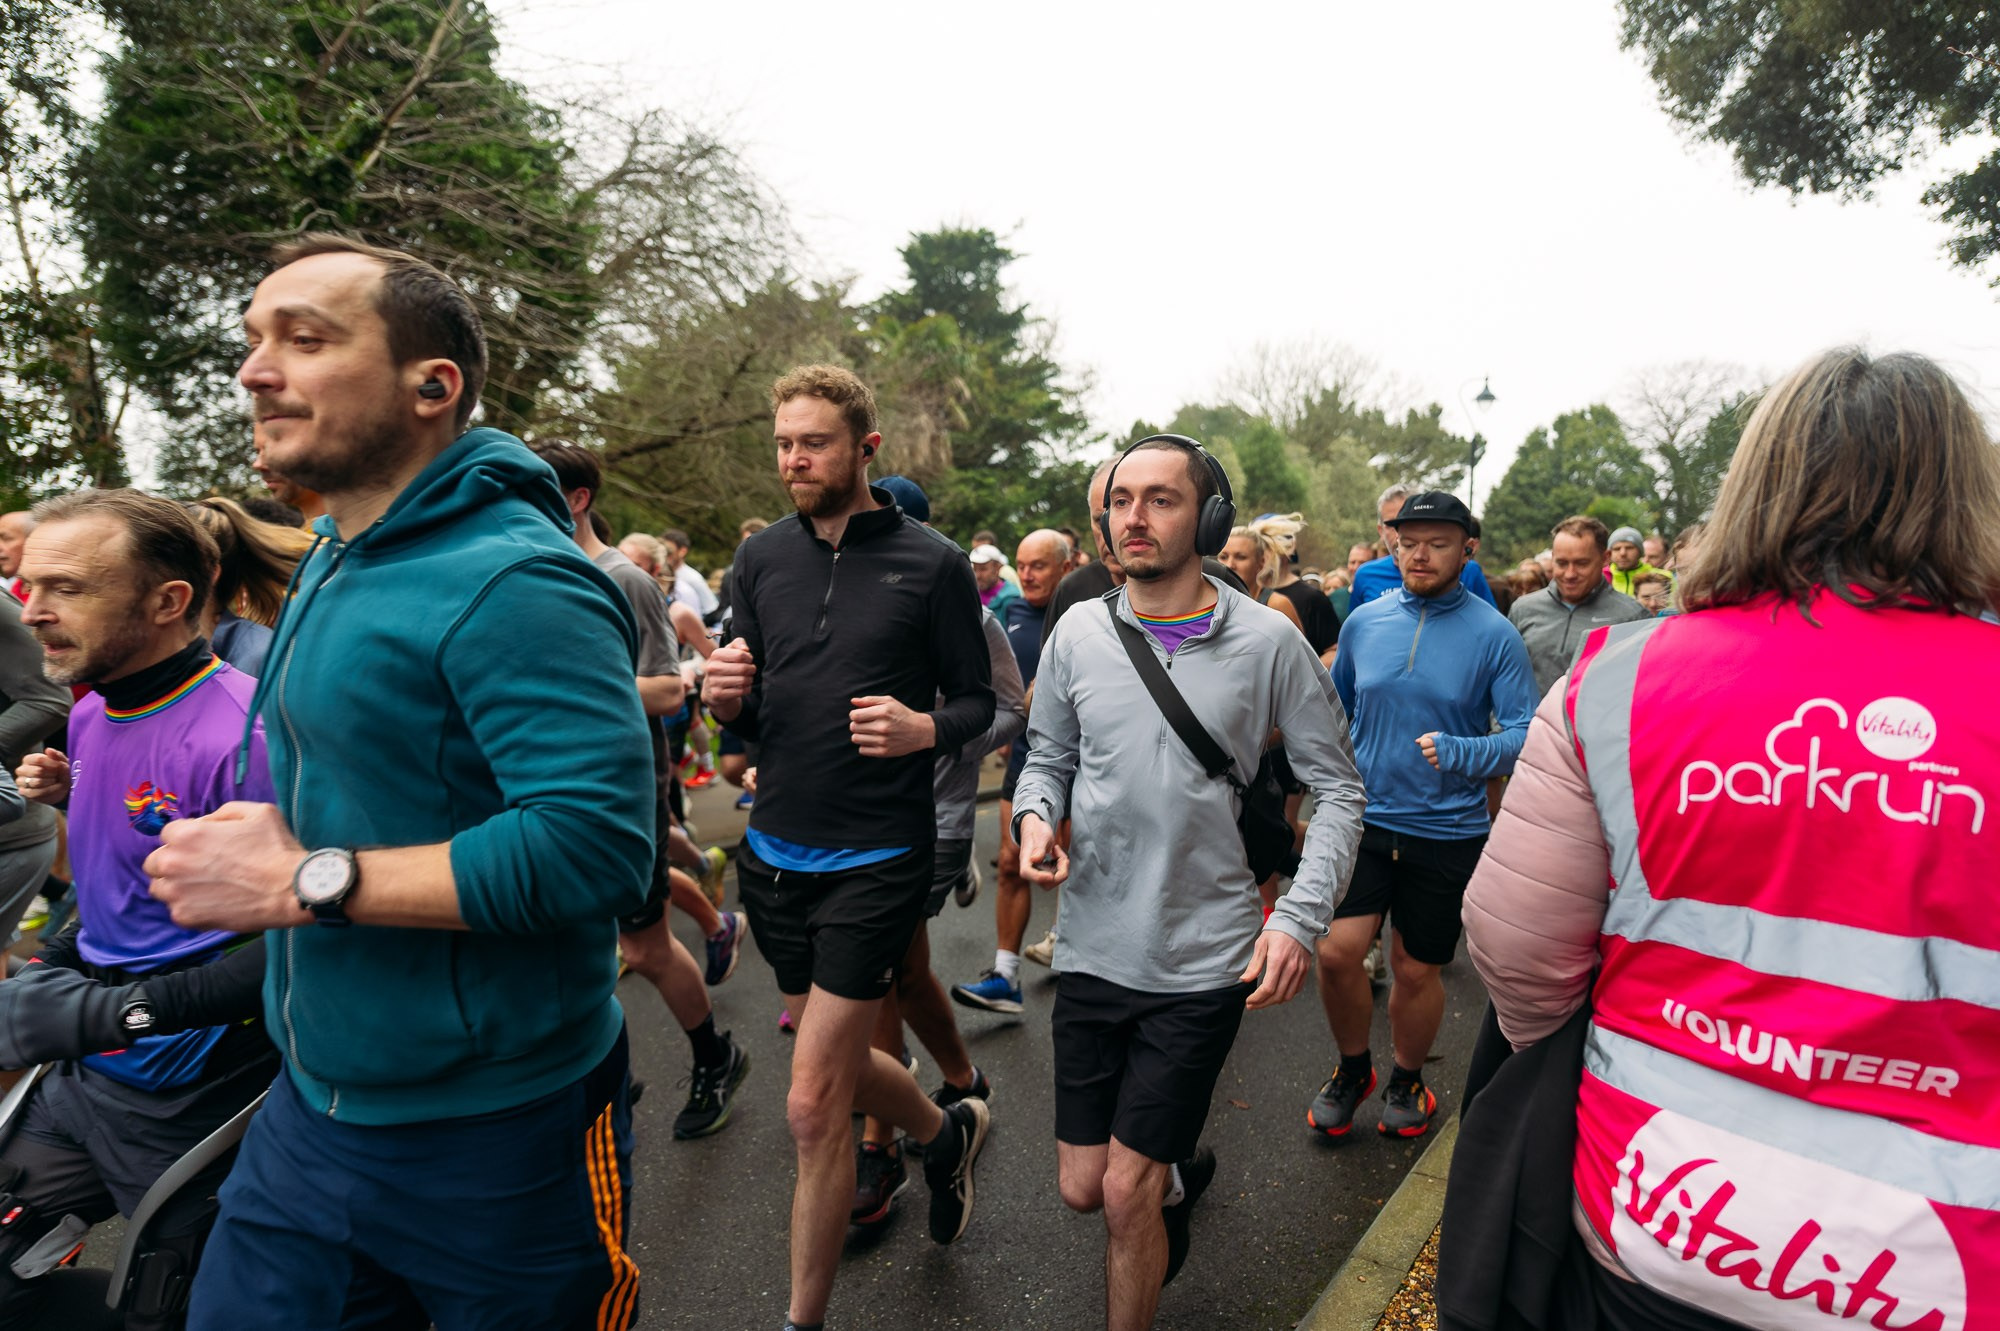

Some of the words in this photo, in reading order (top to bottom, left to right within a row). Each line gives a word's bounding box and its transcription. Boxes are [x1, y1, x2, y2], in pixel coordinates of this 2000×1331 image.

[1862, 713, 1931, 745] Vitality
[1677, 735, 1986, 835] parkrun
[1908, 761, 1960, 776] partners
[1662, 998, 1960, 1098] VOLUNTEER
